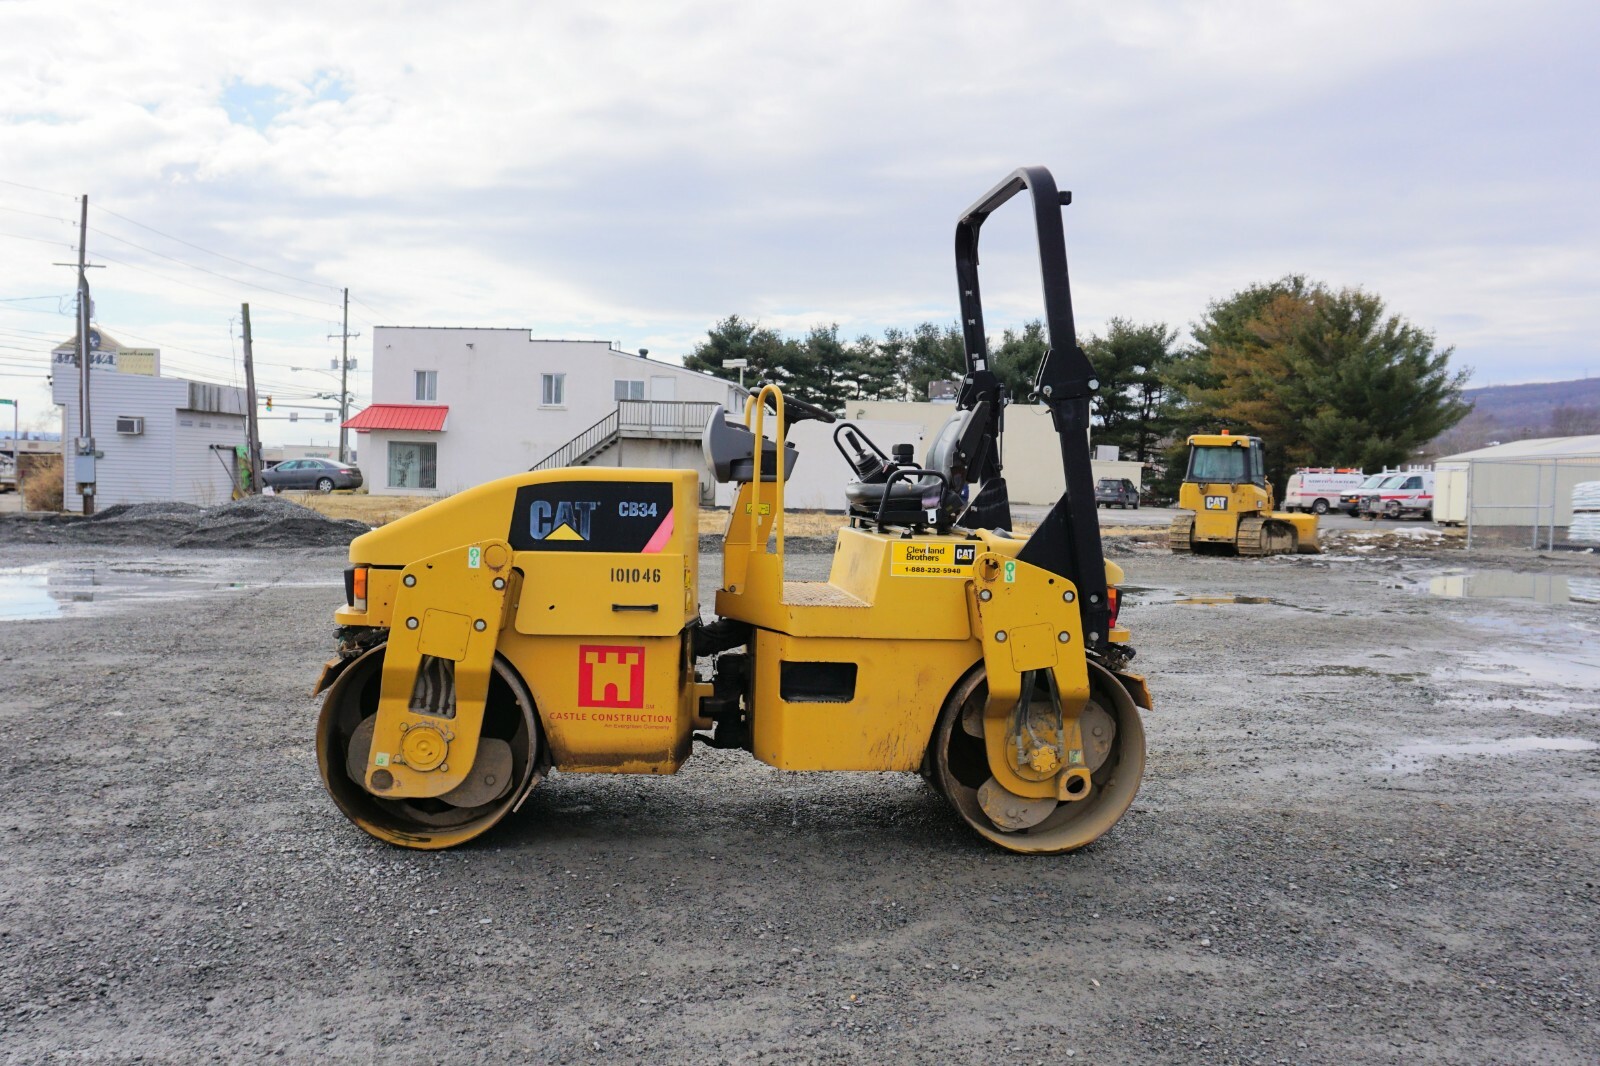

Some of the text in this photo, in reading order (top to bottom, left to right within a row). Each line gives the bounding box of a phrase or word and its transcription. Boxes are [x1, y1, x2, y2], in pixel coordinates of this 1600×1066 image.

[1206, 496, 1226, 509] CAT
[618, 501, 657, 517] CB34
[529, 500, 596, 540] CAT
[906, 546, 945, 554] Cleveland
[956, 548, 974, 560] CAT
[906, 553, 940, 562] Brothers
[610, 567, 661, 583] 101046
[549, 712, 672, 723] CASTLE CONSTRUCTION
